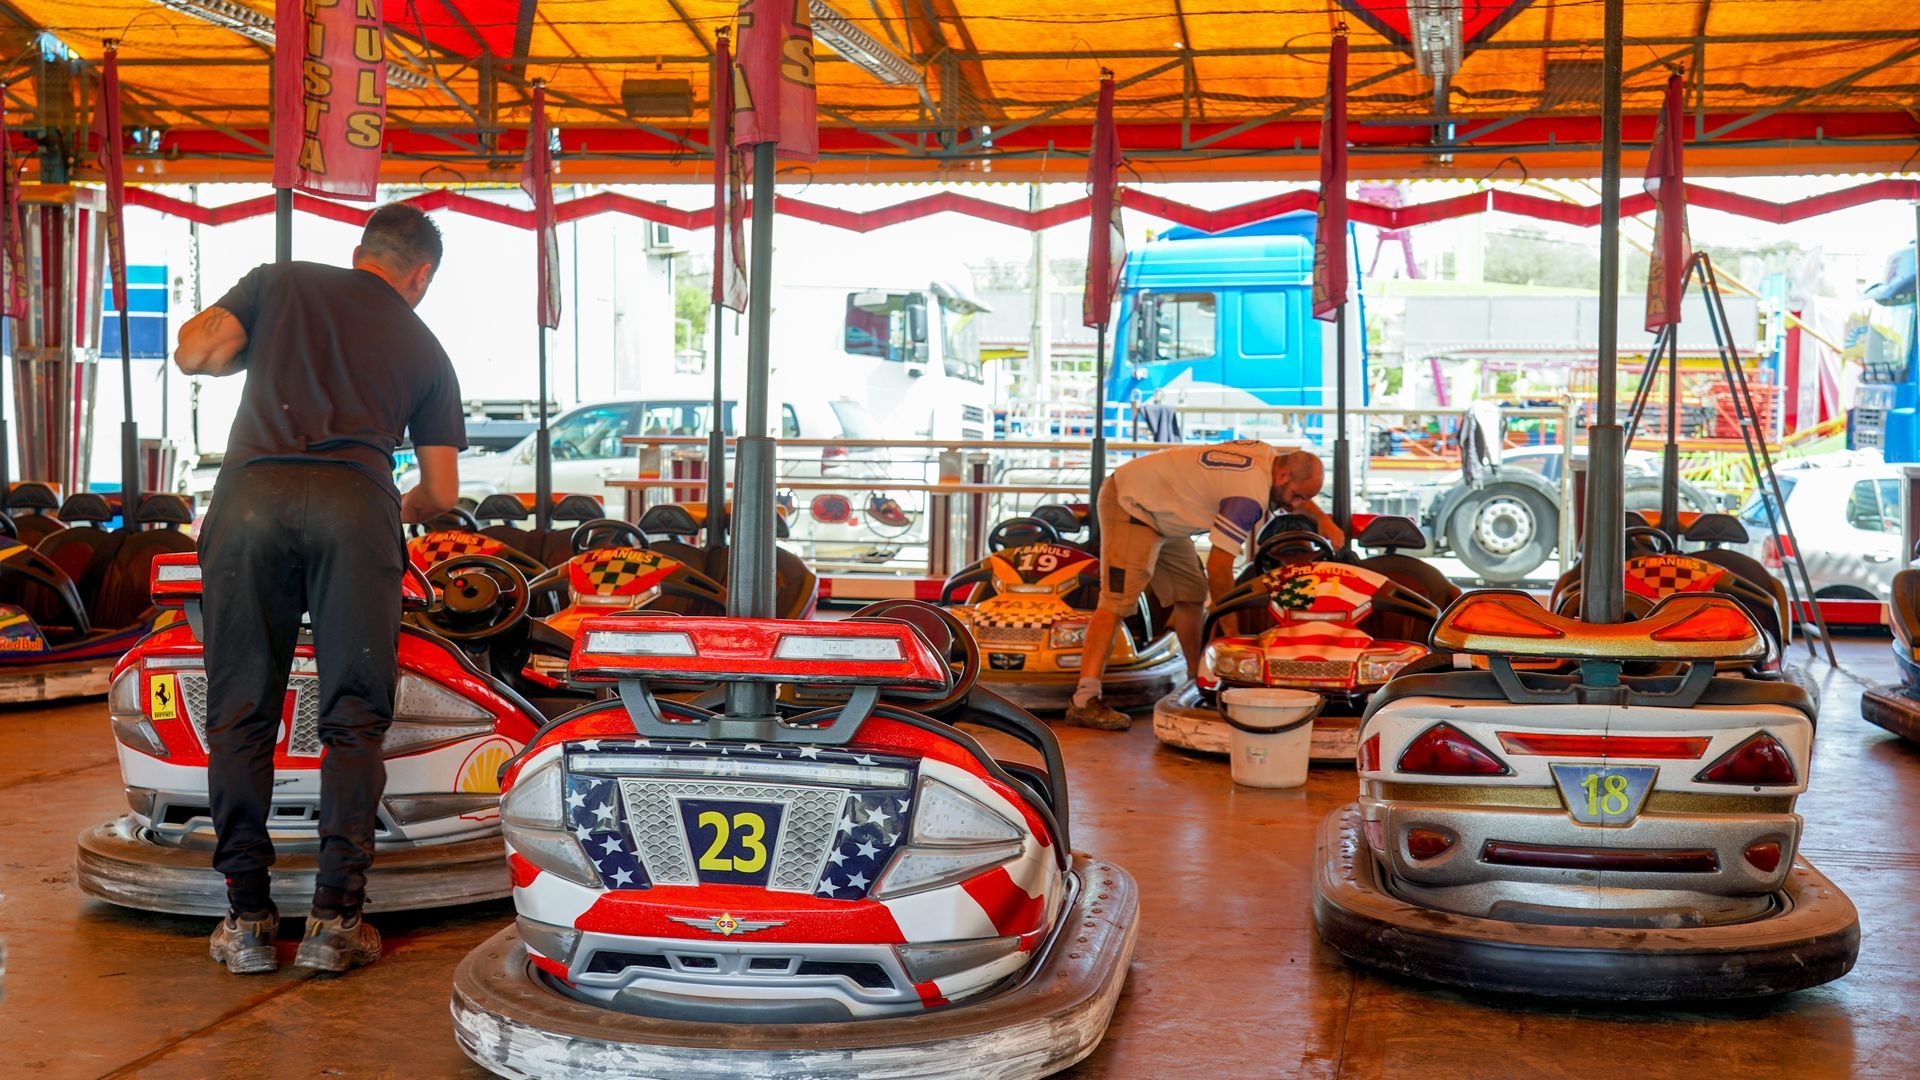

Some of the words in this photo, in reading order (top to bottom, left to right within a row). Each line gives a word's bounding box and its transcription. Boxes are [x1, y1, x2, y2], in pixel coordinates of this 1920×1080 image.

[1017, 554, 1058, 572] 19
[1298, 575, 1344, 596] 21
[991, 601, 1056, 610] TAXI
[1580, 773, 1629, 815] 18
[698, 811, 767, 873] 23
